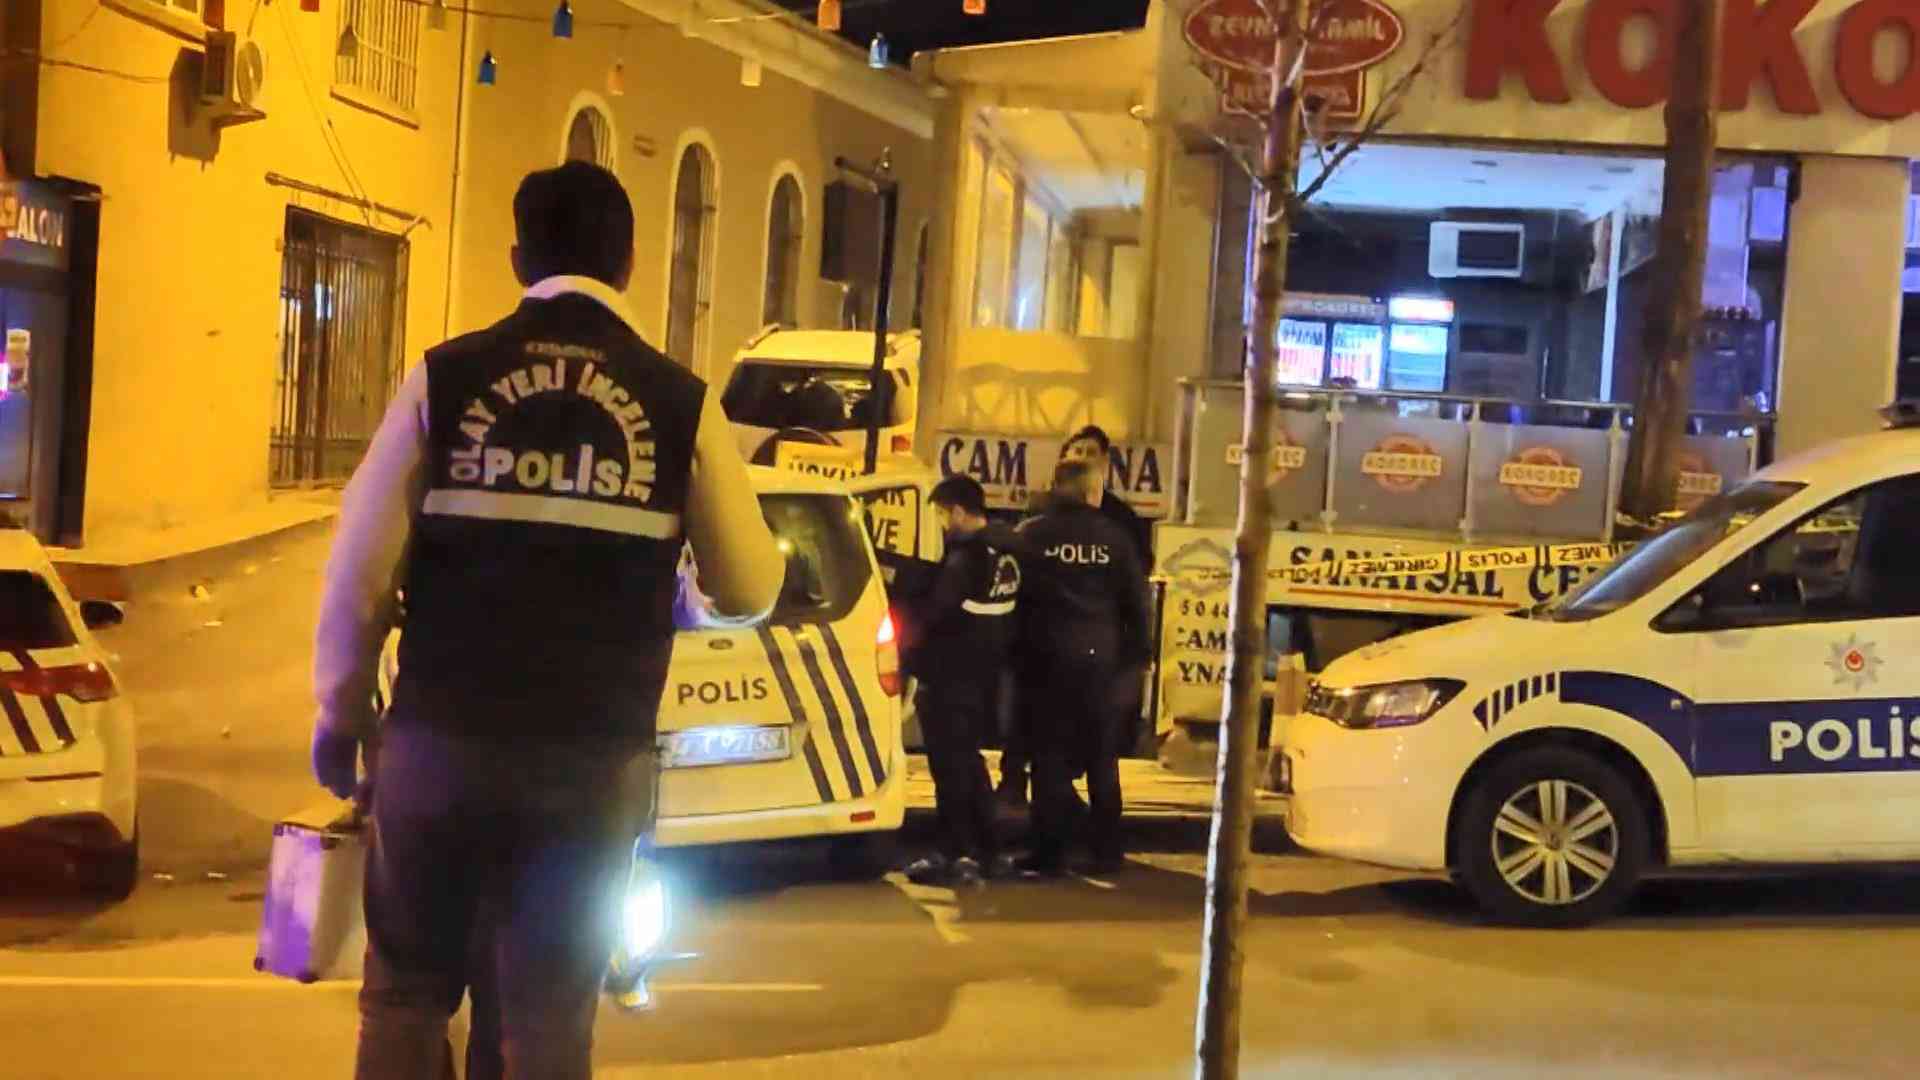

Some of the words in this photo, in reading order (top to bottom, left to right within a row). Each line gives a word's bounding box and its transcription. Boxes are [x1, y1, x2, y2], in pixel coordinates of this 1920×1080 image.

[1318, 18, 1386, 41] AMİL
[450, 398, 497, 482] OLAY
[491, 357, 566, 405] YERİ
[483, 443, 624, 497] POLİS
[940, 437, 1028, 485] CAM
[677, 675, 768, 705] POLİS
